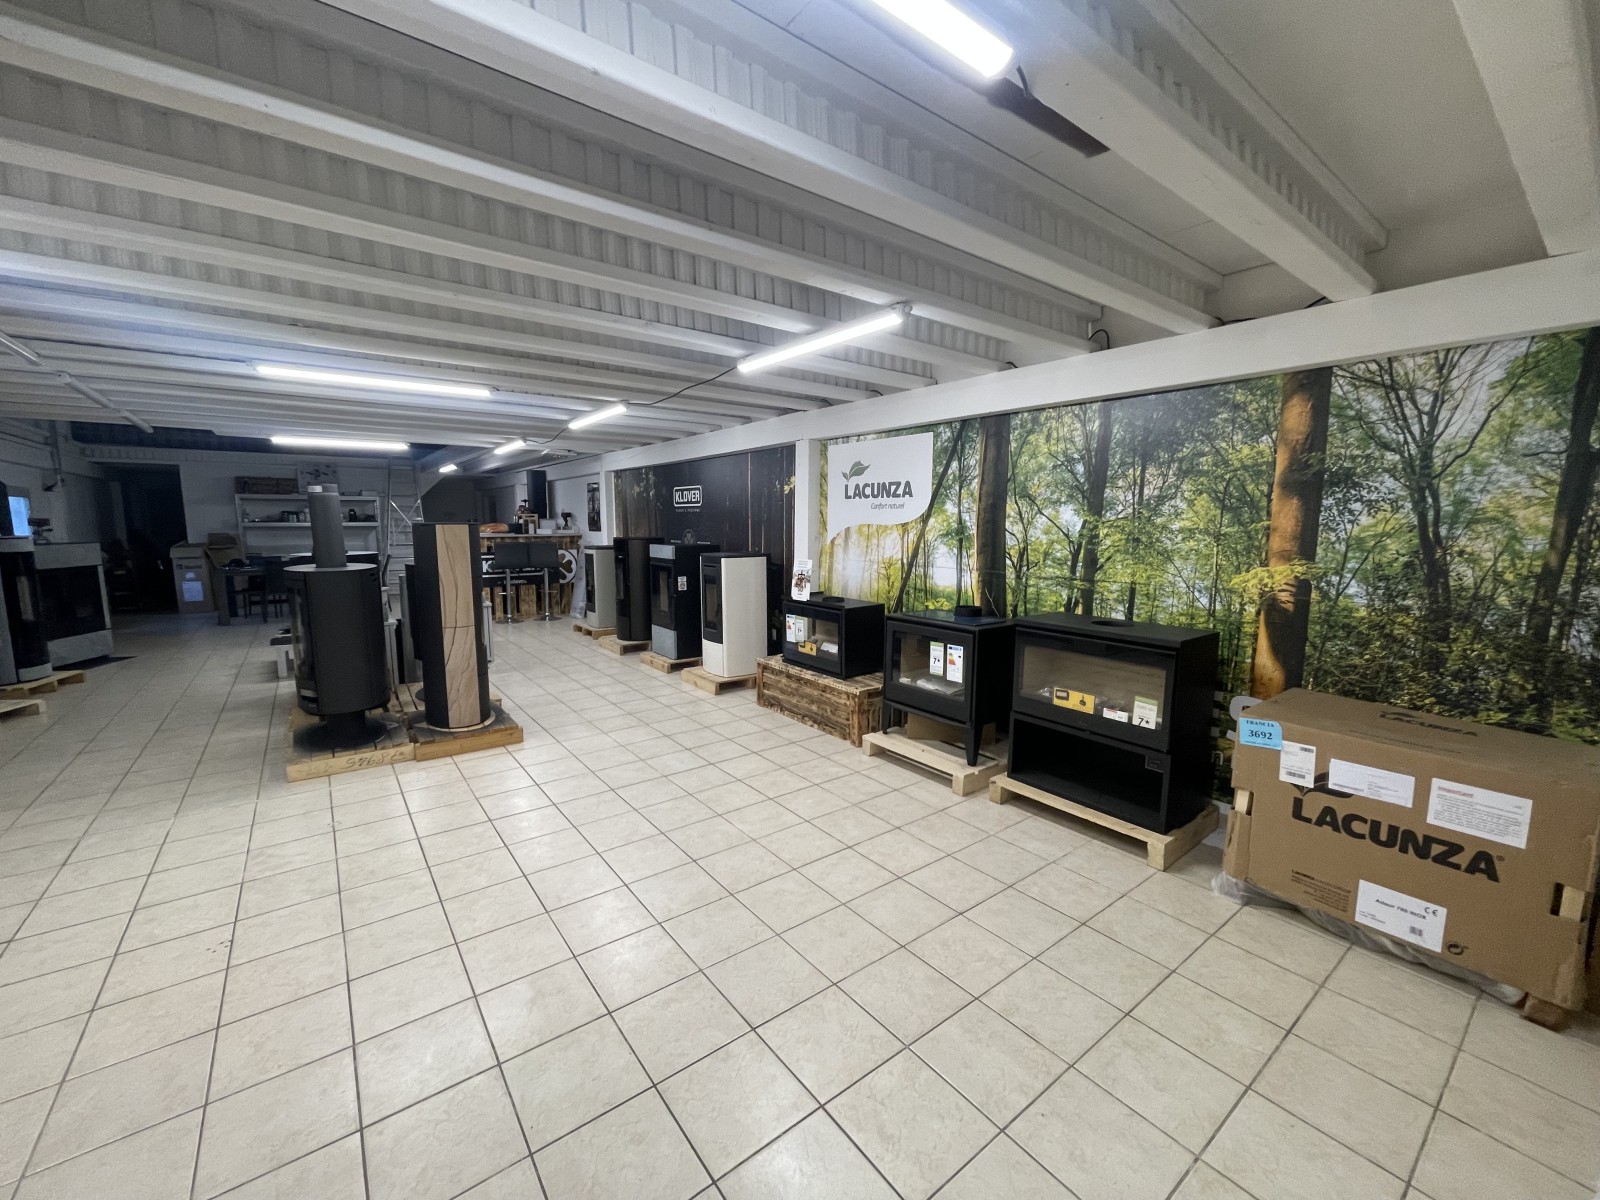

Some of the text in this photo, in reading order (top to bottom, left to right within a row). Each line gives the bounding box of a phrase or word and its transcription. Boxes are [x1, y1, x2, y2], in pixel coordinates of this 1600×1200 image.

[675, 490, 700, 503] KLOVER
[844, 480, 913, 500] LACUNZA
[870, 501, 905, 511] Confort naturel
[1248, 729, 1273, 740] 3692
[1292, 798, 1500, 883] LACUNZA
